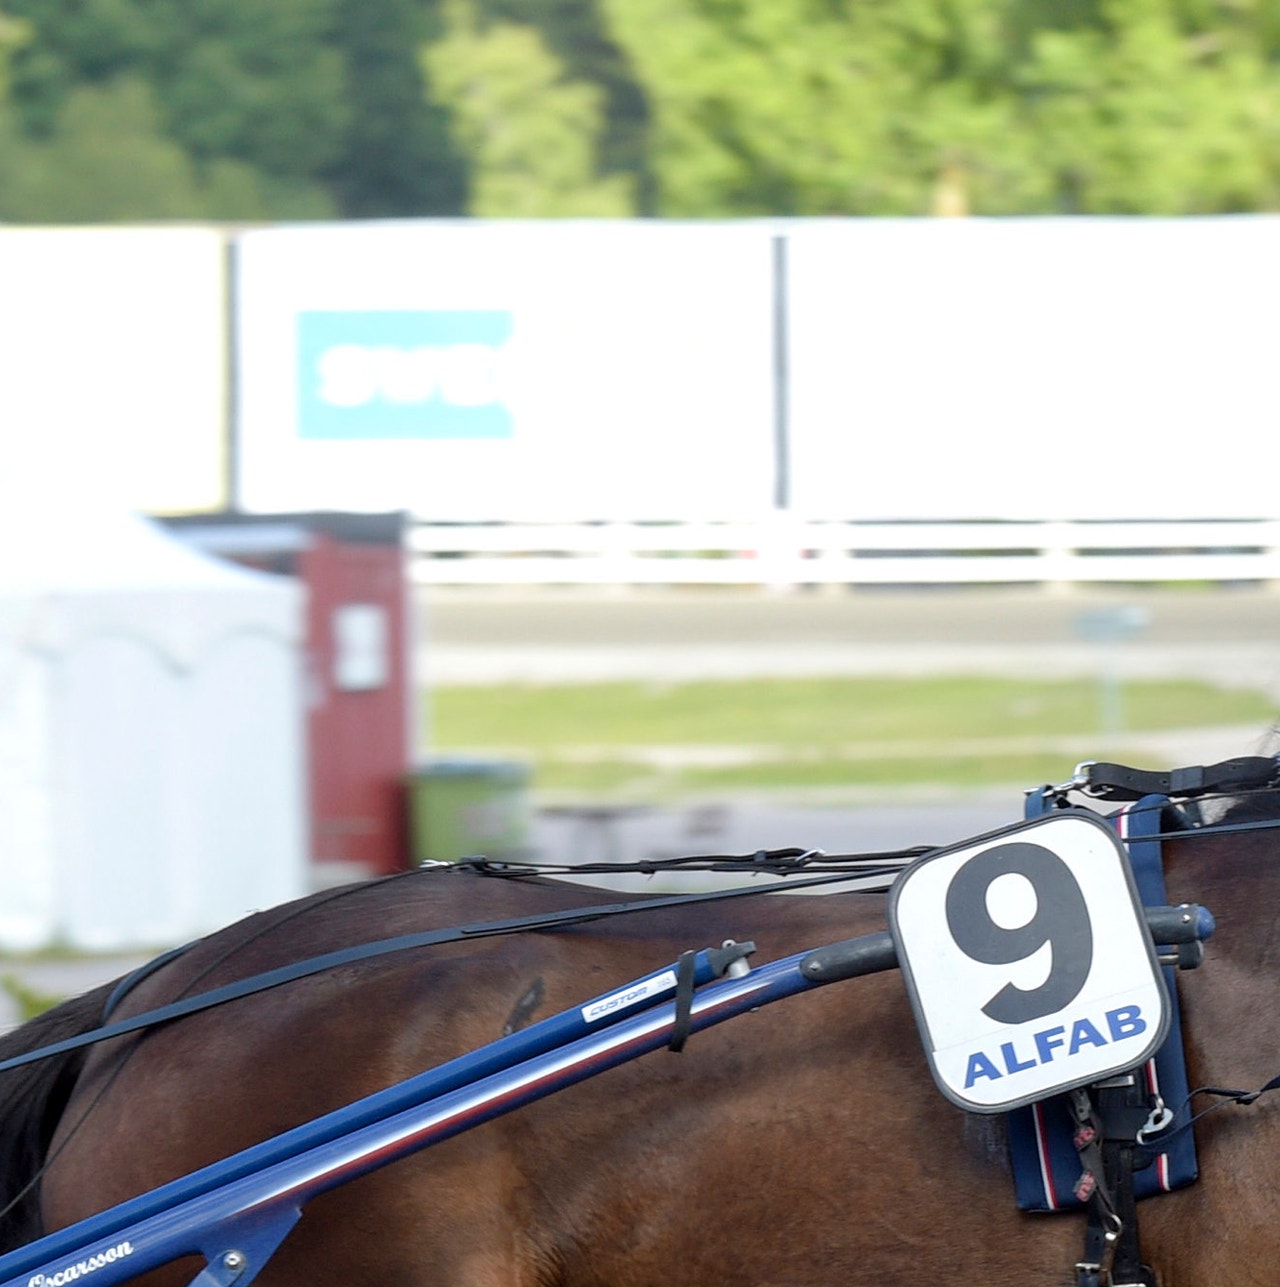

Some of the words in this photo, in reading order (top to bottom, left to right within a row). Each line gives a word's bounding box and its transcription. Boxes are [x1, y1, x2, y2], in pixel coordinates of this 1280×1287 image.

[945, 842, 1094, 1025] 9
[589, 985, 649, 1017] CUSTOM
[963, 1004, 1148, 1090] ALFAB
